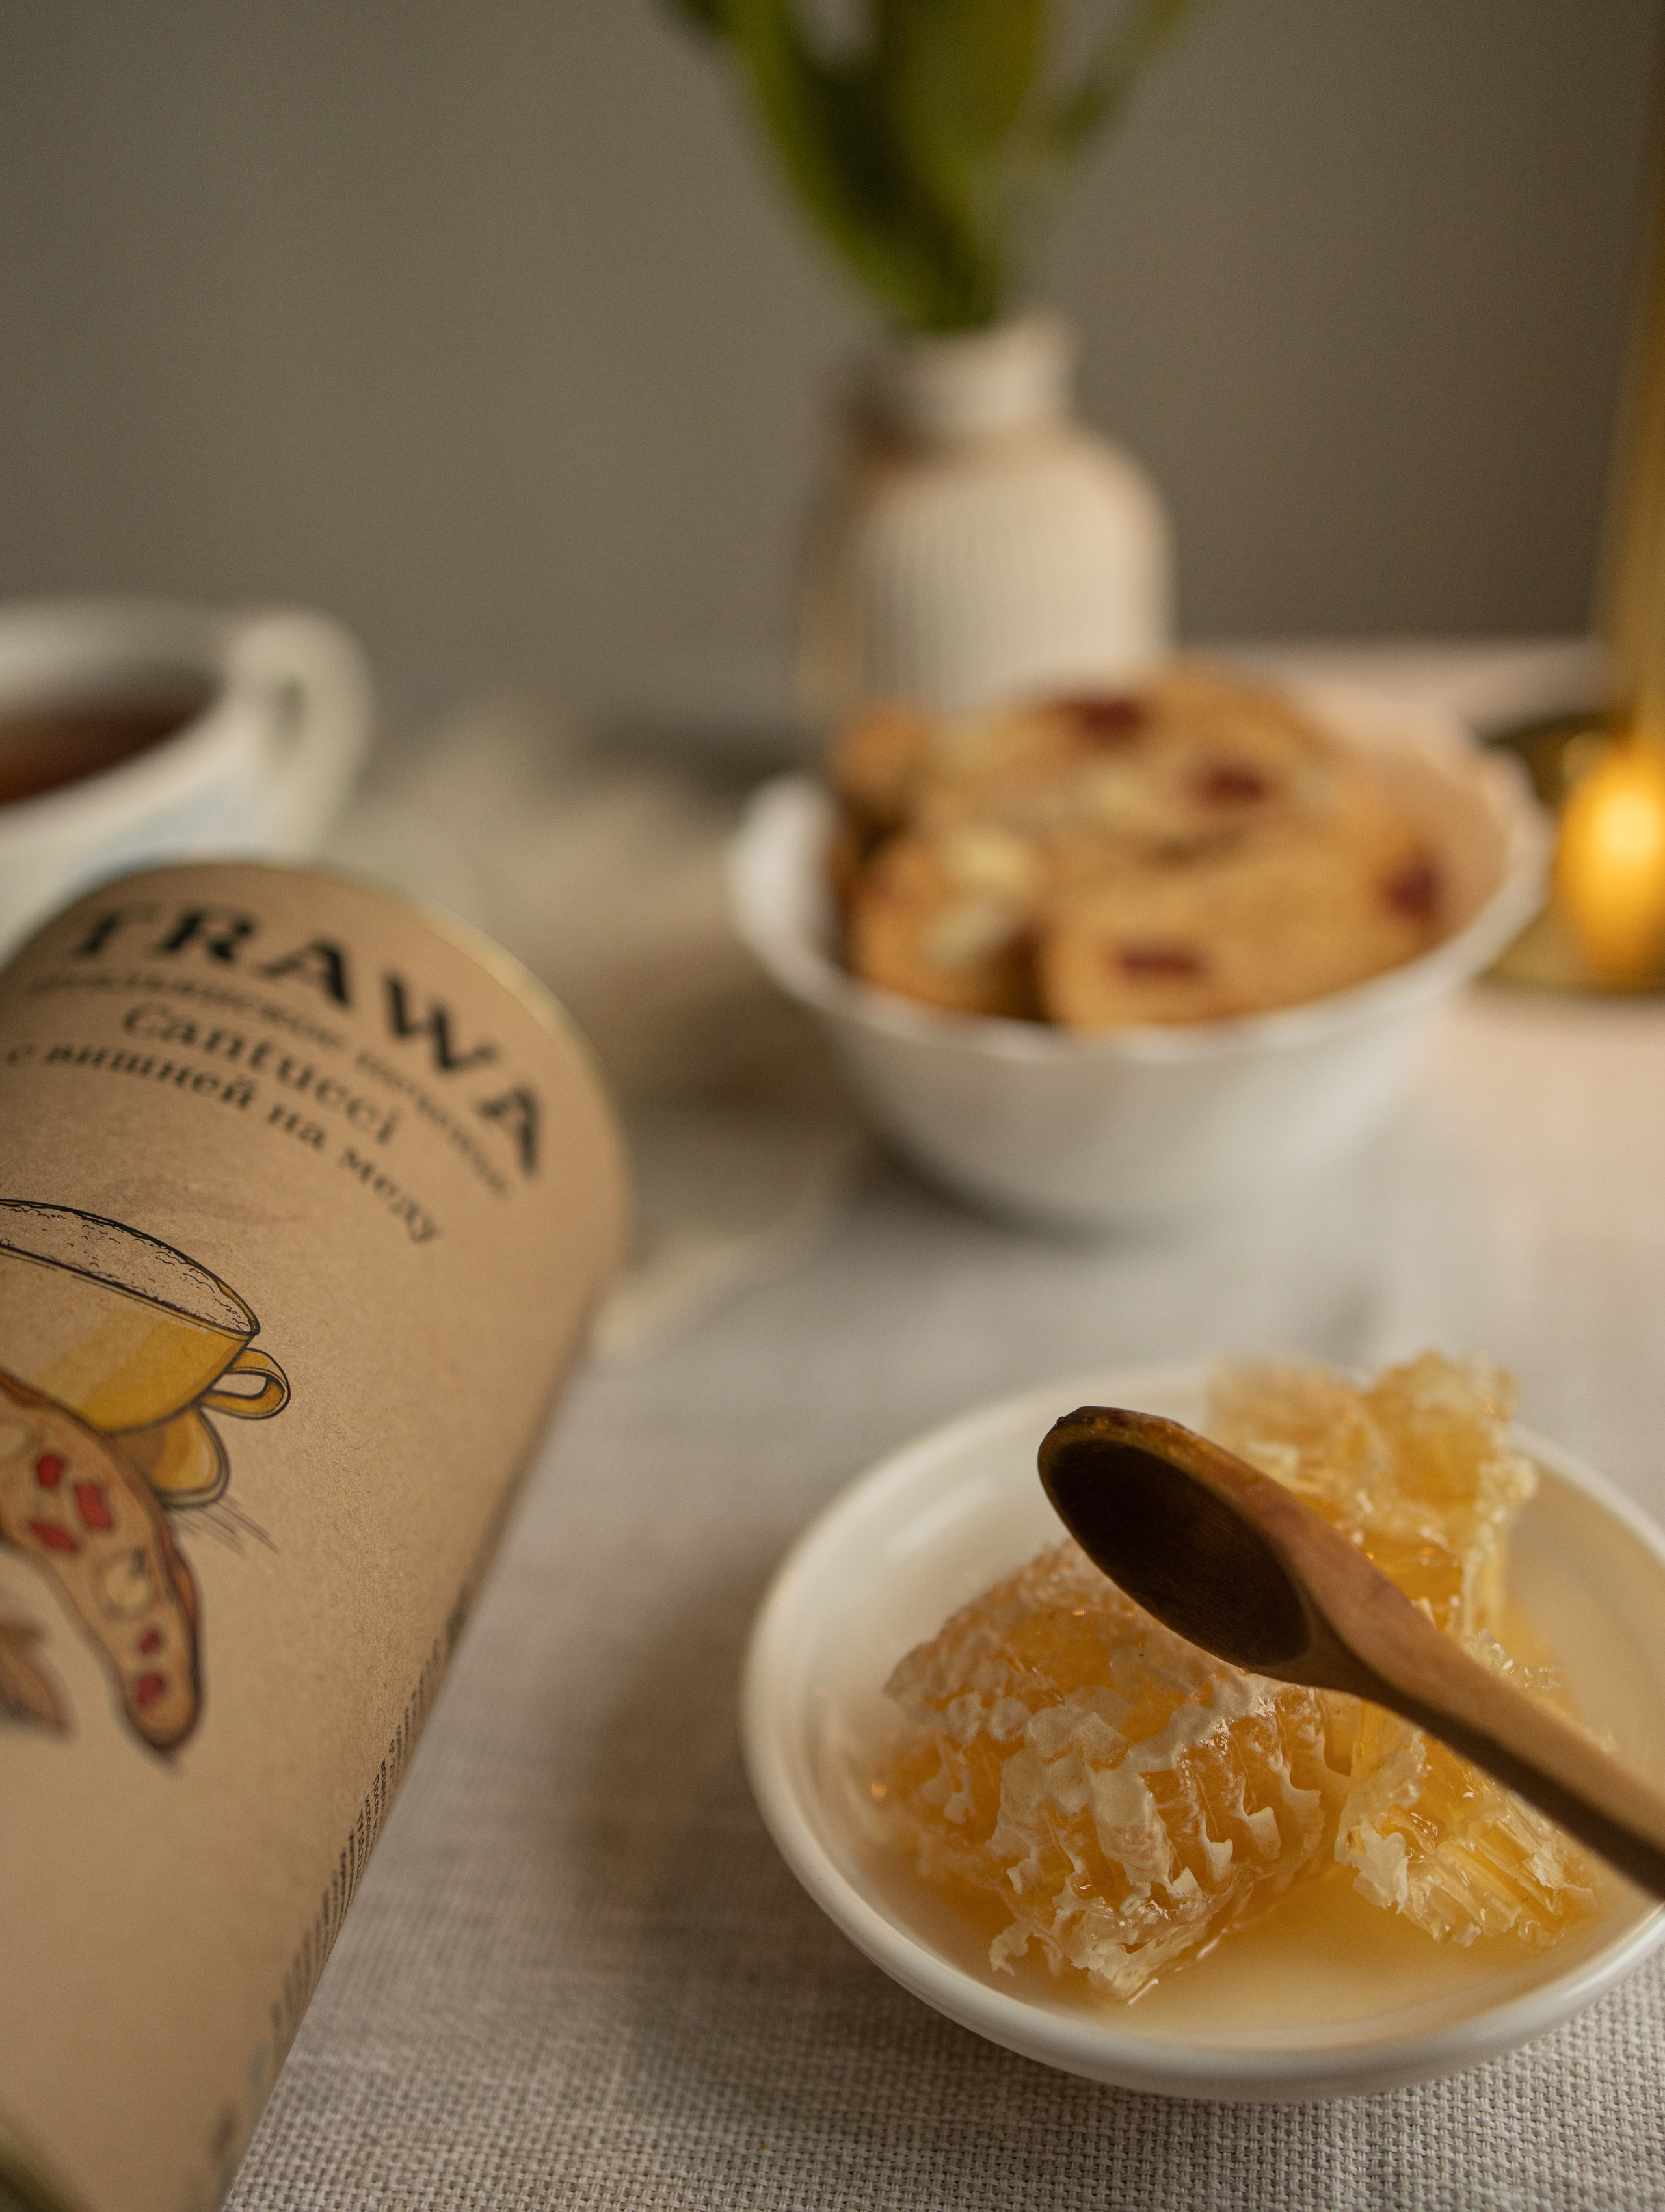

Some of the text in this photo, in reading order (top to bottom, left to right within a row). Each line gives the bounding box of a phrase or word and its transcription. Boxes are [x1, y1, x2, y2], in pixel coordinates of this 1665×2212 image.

[44, 1042, 258, 1111] вишней
[265, 1100, 329, 1153] на
[73, 905, 545, 1179] TRAWA
[121, 1002, 401, 1145] Cantucci
